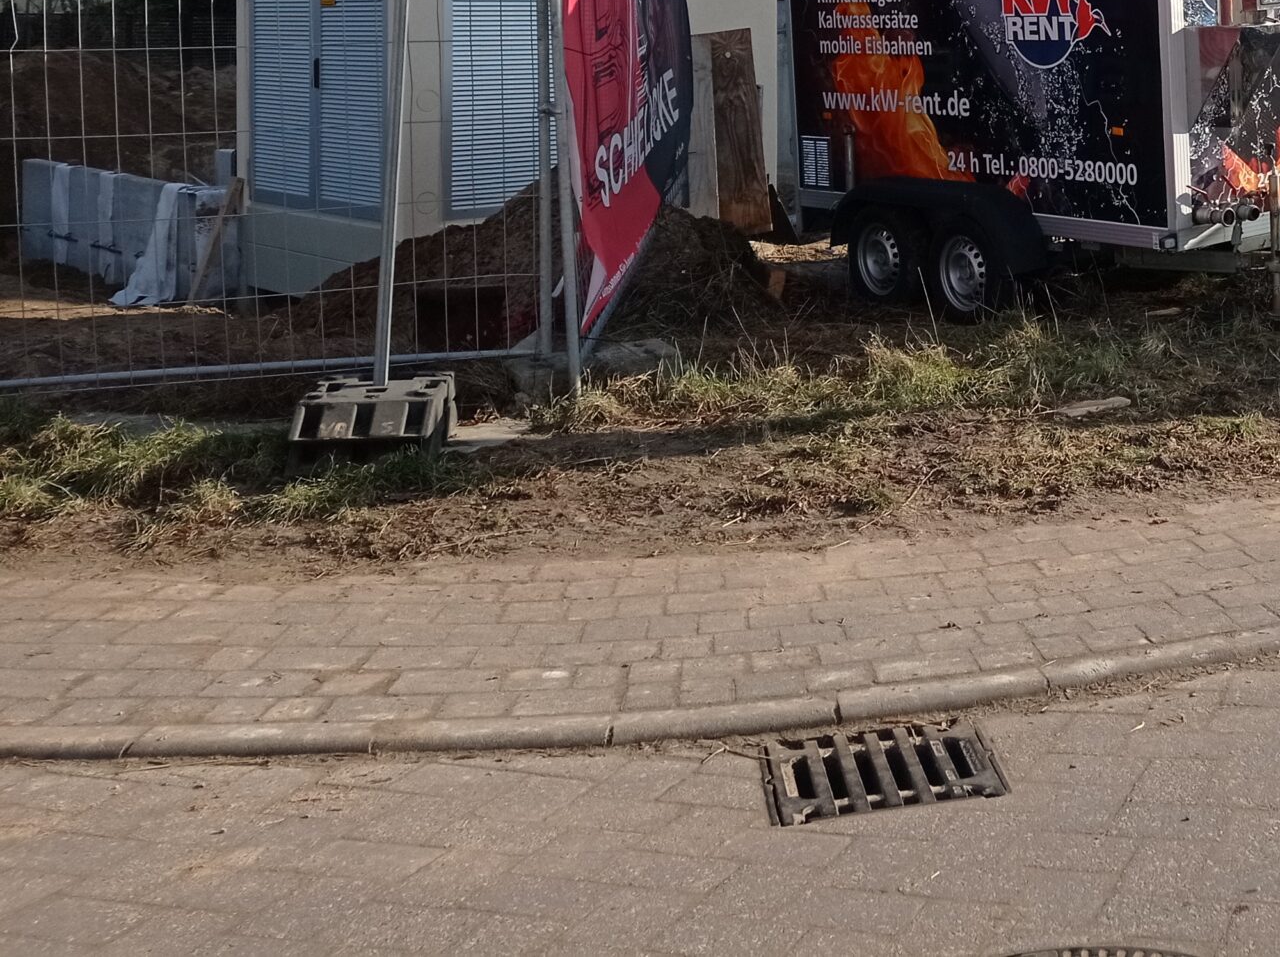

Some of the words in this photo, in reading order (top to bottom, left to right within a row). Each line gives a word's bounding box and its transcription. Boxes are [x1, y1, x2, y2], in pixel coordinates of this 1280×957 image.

[818, 10, 919, 31] Kaltwassersätze
[1005, 15, 1076, 43] RENT
[819, 36, 862, 55] mobile
[865, 37, 932, 56] Eisbahnen
[823, 89, 970, 118] www.kW-rent.de
[948, 151, 966, 170] 24
[970, 153, 979, 172] h
[983, 154, 1014, 174] Tel.:
[1019, 156, 1138, 186] 0800-5280000
